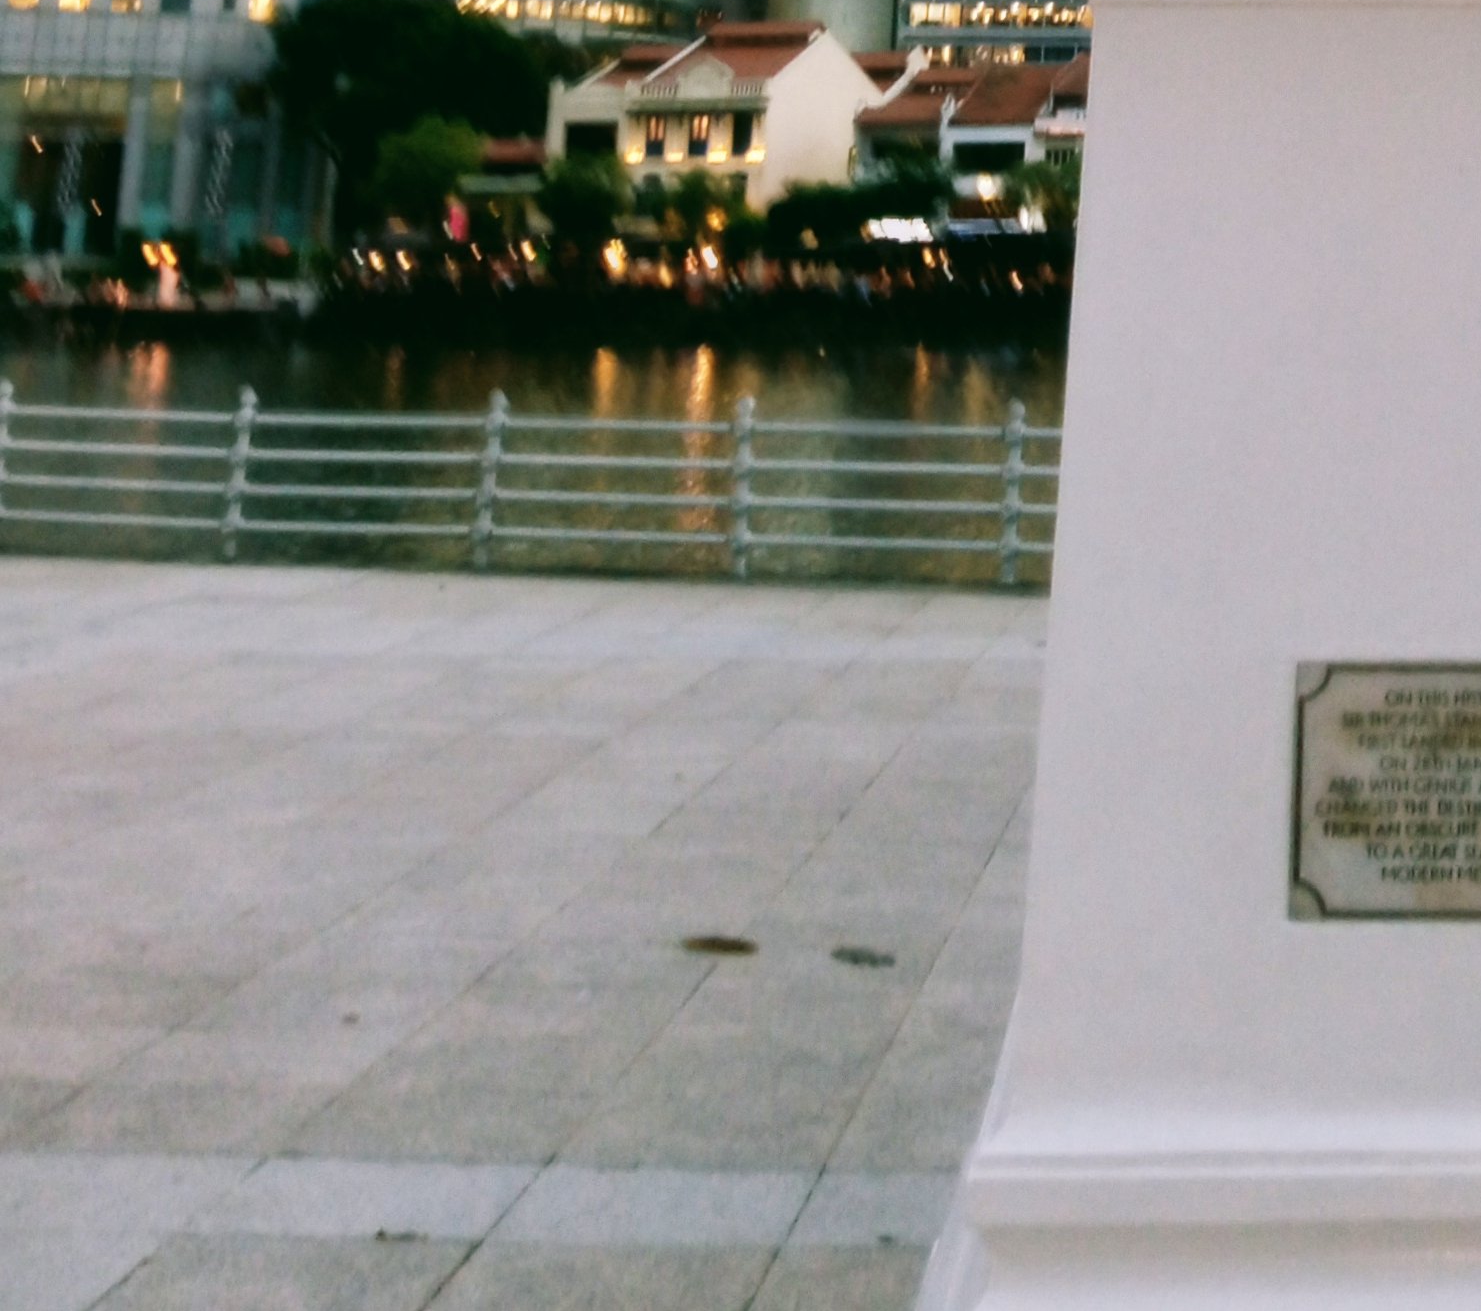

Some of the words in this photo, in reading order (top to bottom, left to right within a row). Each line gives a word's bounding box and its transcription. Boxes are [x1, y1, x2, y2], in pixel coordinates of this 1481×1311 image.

[1370, 776, 1408, 793] WITH
[1404, 799, 1428, 816] THE
[1365, 843, 1388, 860] TO
[1392, 844, 1404, 859] A
